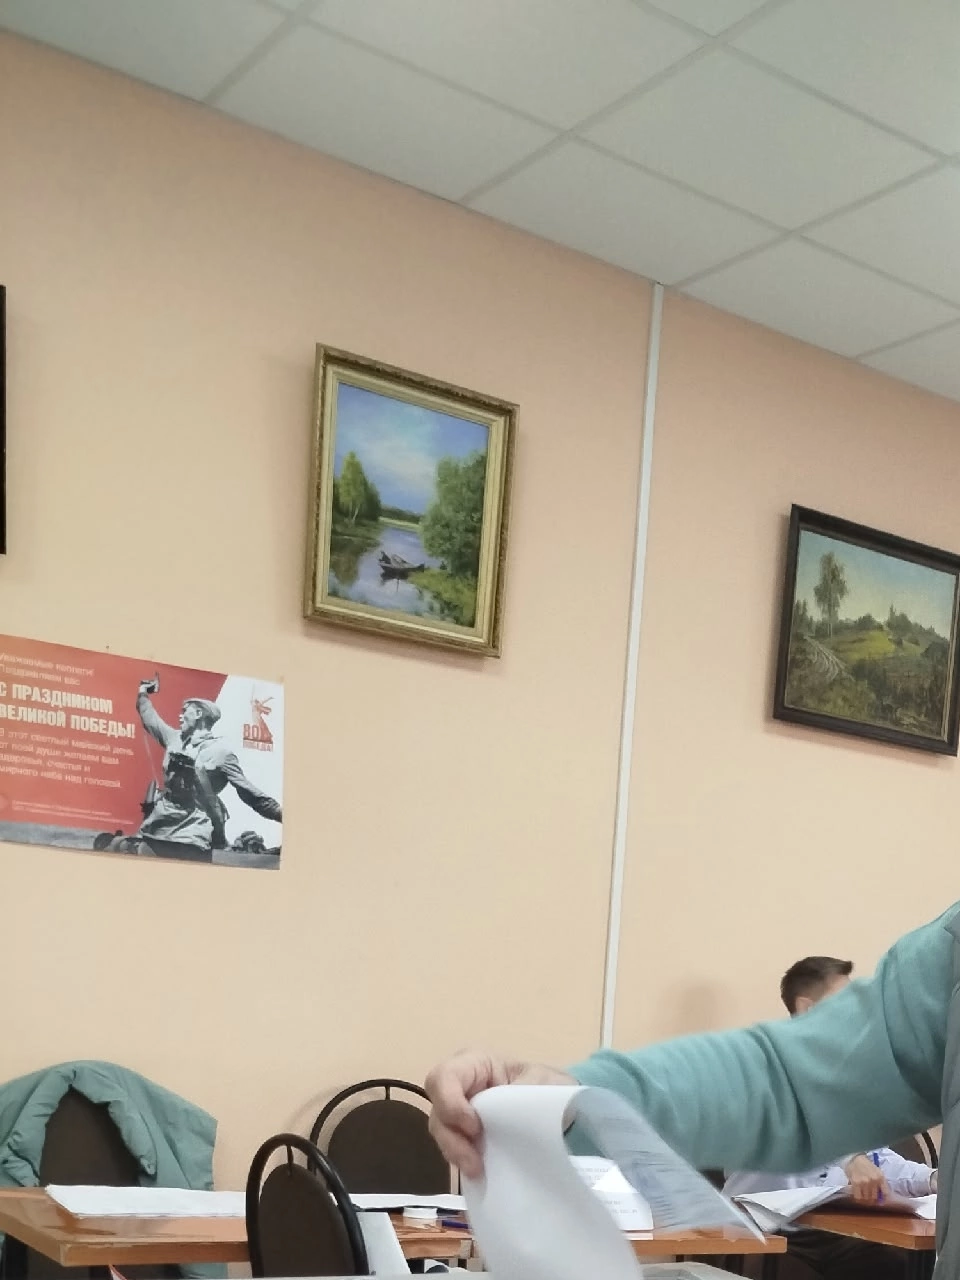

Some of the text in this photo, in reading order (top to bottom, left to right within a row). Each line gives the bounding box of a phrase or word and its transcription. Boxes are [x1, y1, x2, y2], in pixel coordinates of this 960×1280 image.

[12, 683, 113, 714] ПРАЗДНИКОМ
[0, 703, 136, 739] ВЕЛИКОЙ ПОБЕДЫ!
